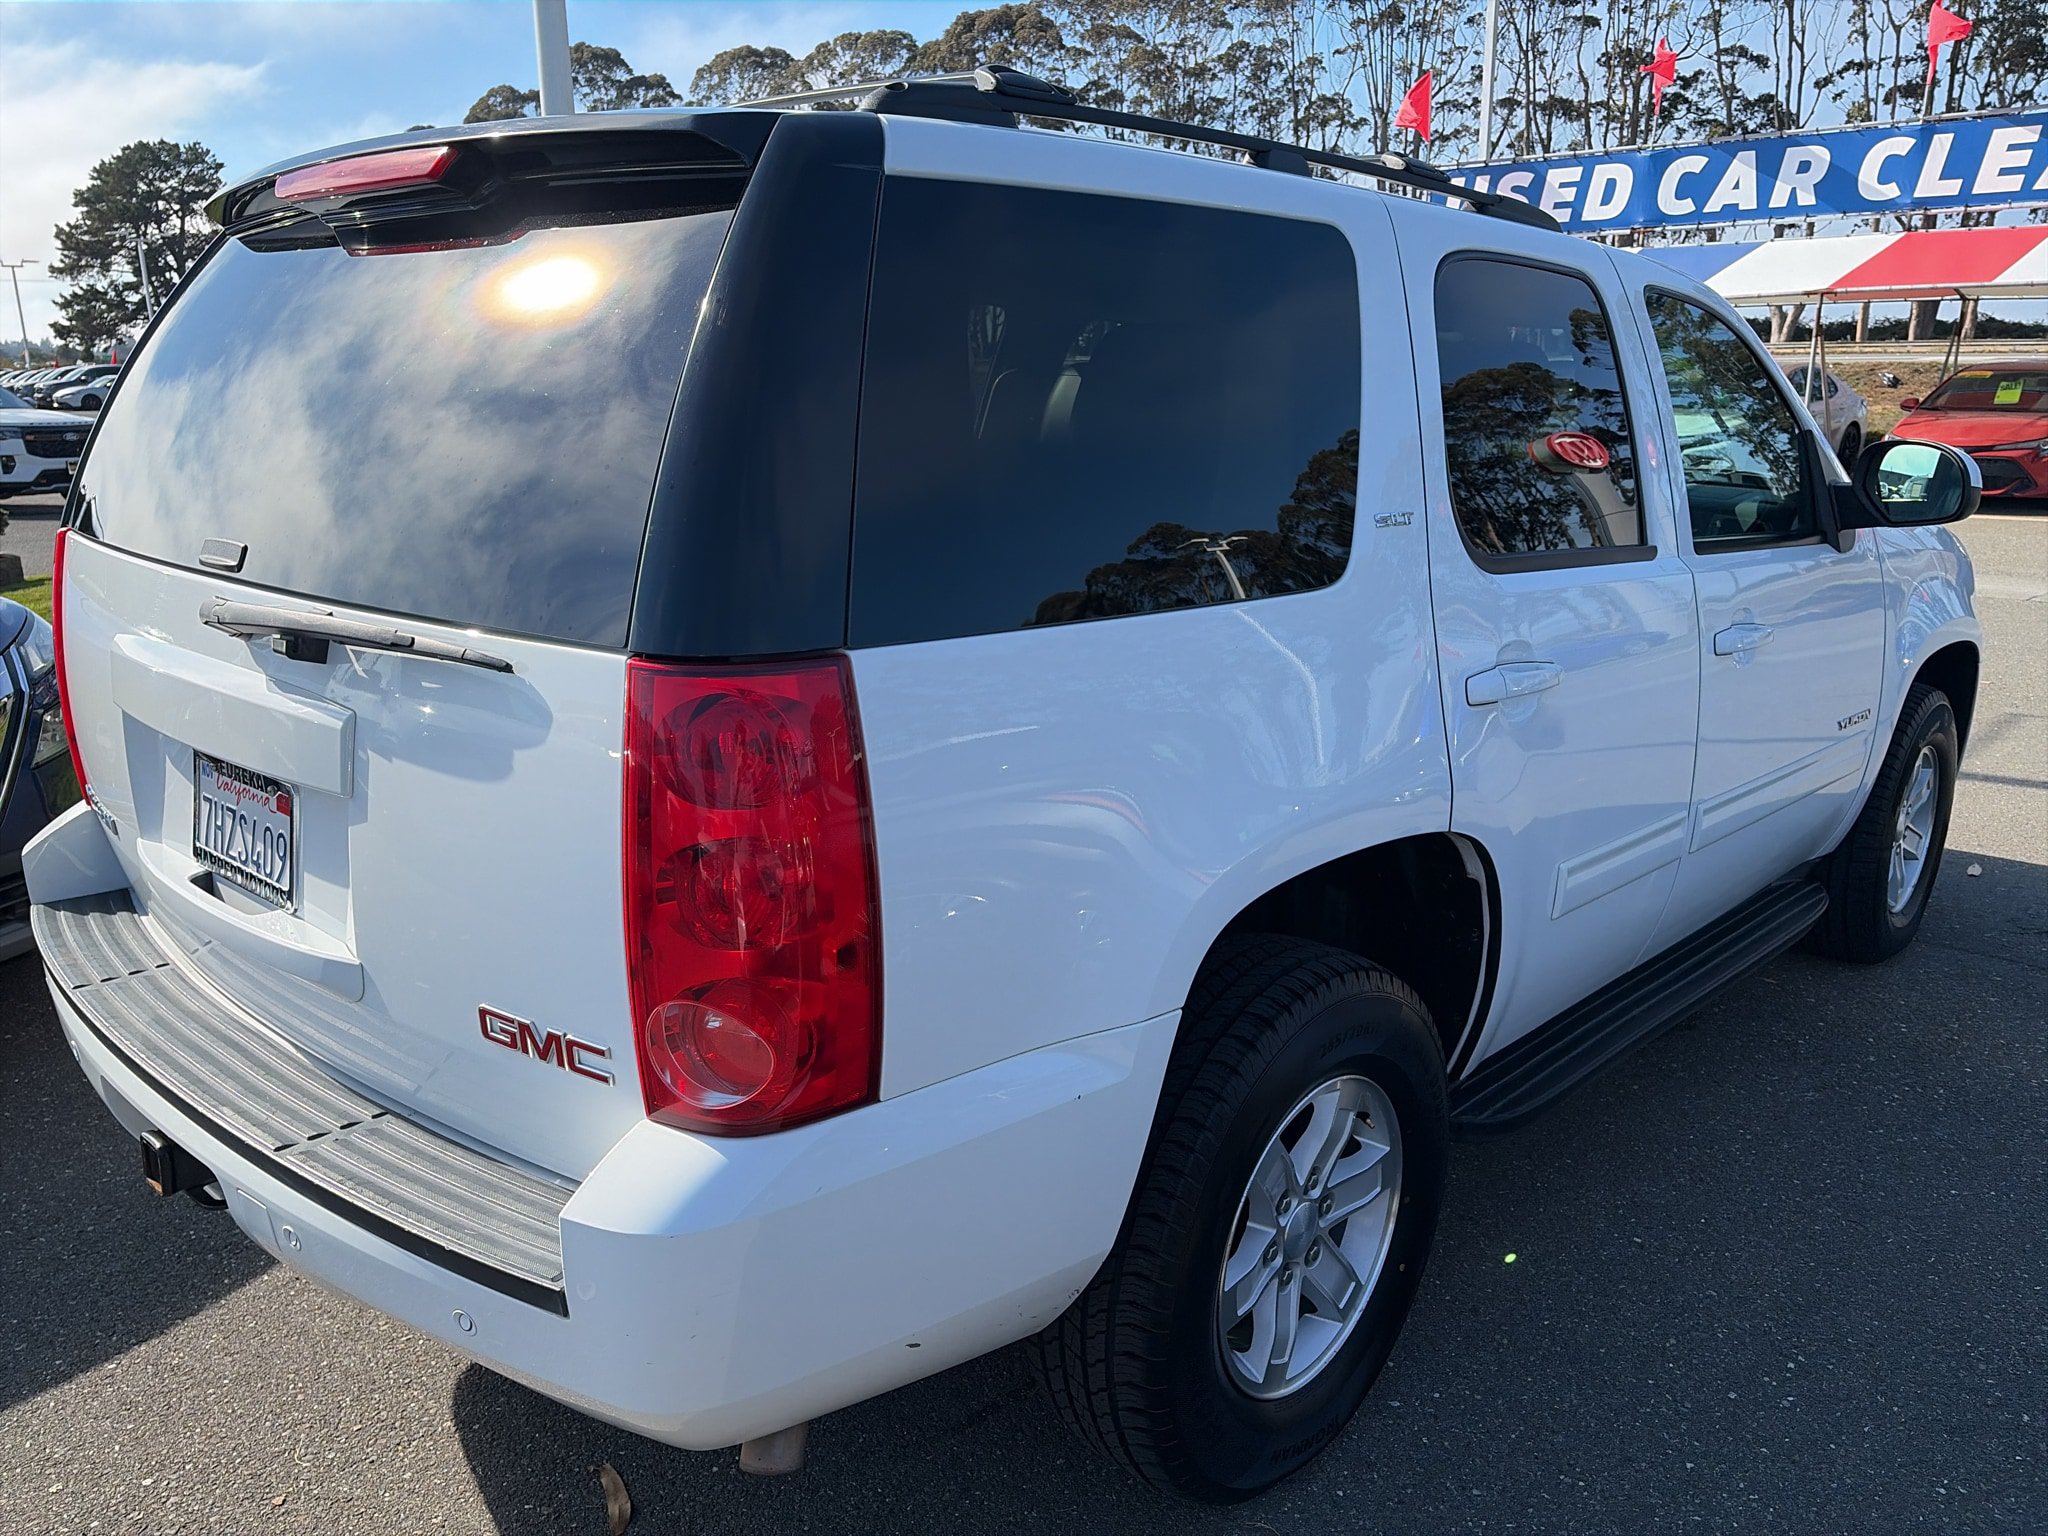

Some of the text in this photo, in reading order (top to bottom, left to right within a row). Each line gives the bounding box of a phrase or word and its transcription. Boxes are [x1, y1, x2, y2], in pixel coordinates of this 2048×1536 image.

[1657, 146, 1831, 216] CAR
[1858, 125, 2048, 201] CLE
[1374, 512, 1414, 528] SLT
[220, 759, 265, 792] EUREKA
[203, 793, 288, 884] 7HZS409
[478, 1003, 616, 1087] GMC
